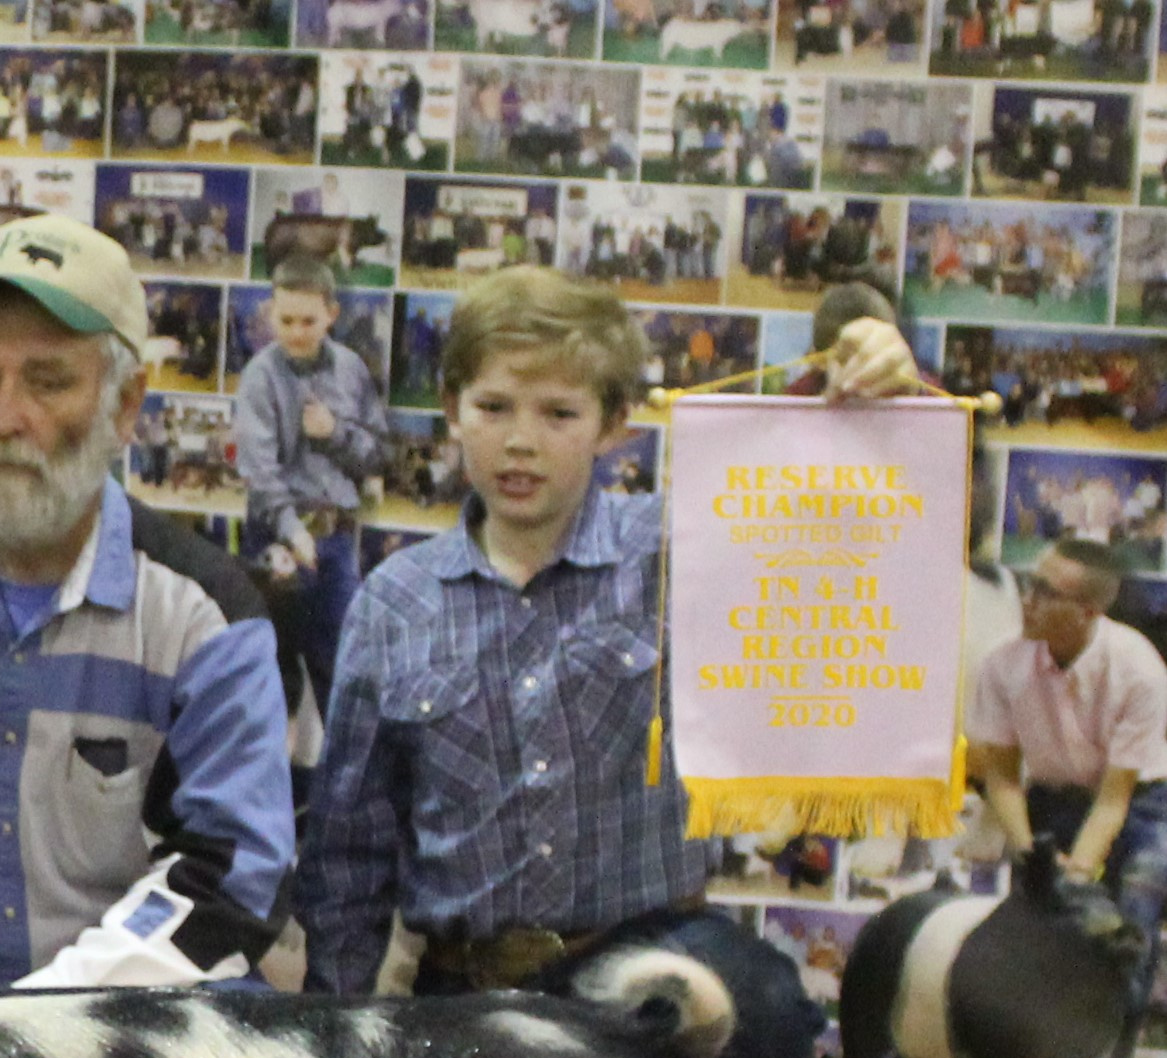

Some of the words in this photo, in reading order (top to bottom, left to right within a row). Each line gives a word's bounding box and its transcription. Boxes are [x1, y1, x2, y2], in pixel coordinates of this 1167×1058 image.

[725, 464, 908, 491] RESERVE
[711, 492, 925, 520] CHAMPION
[729, 523, 843, 545] SPOTTED
[753, 575, 801, 601] TN
[814, 575, 879, 602] 4-H
[727, 604, 901, 632] CENTRAL
[741, 633, 887, 660] REGION
[697, 662, 810, 691] SWINE
[822, 663, 928, 691] SHOW
[767, 702, 858, 728] 2020
